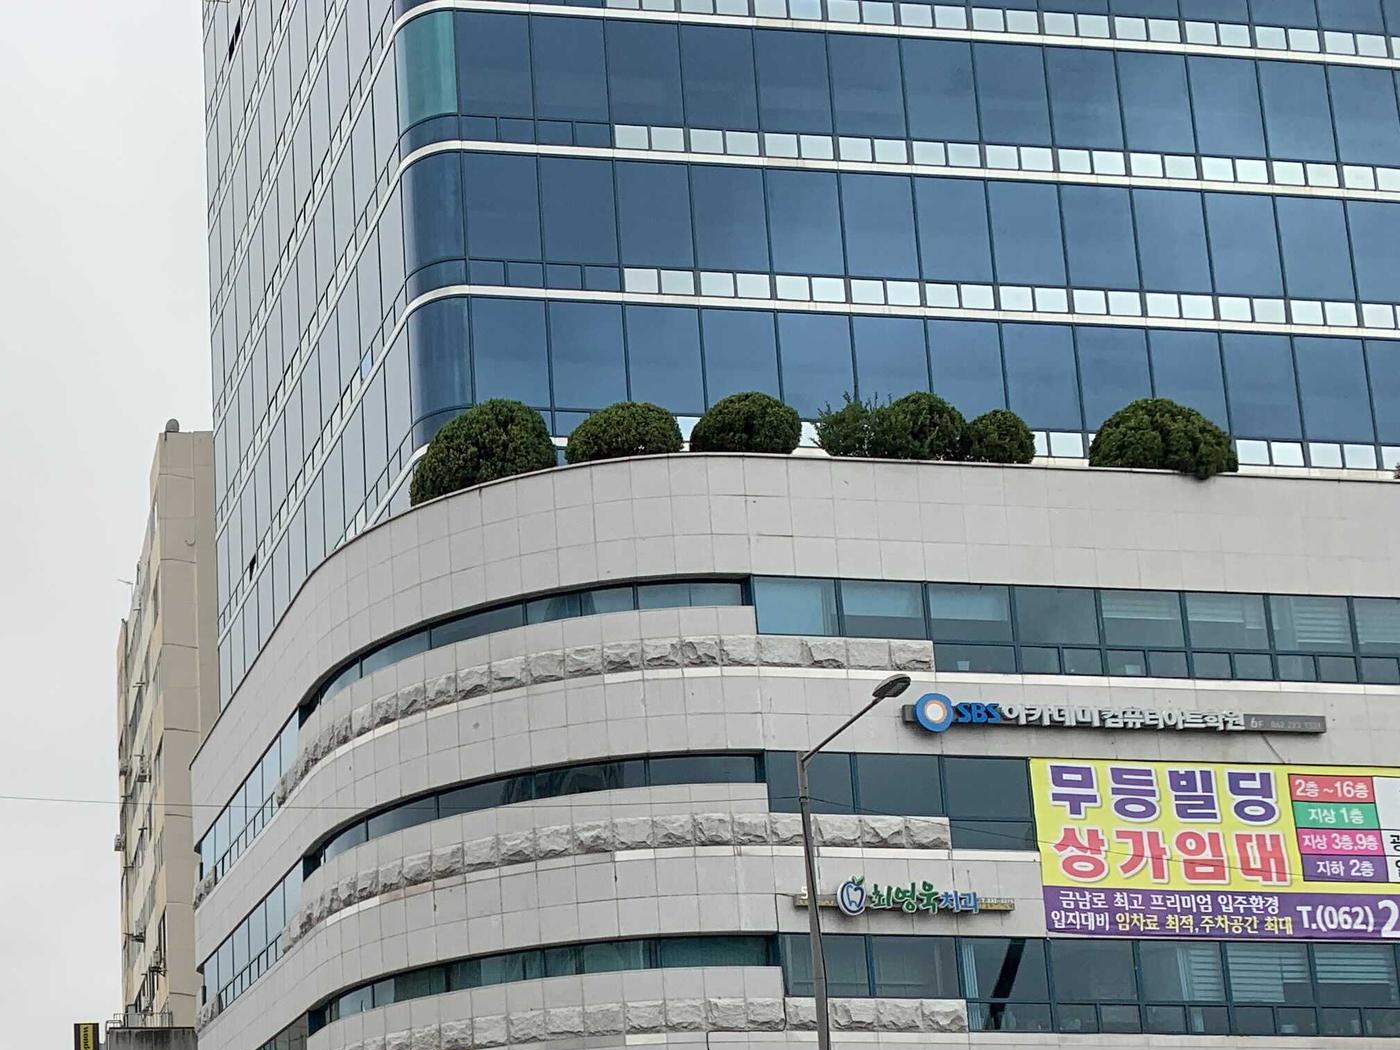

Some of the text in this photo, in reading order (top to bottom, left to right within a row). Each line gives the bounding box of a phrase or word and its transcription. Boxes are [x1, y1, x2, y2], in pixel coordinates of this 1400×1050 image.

[957, 702, 1000, 724] SBS
[1048, 763, 1279, 824] 무등빌딩
[1295, 779, 1320, 797] 2층
[1308, 808, 1364, 824] 지상 1층
[1302, 834, 1327, 850] 지상
[1051, 826, 1290, 884] 상가임대
[1316, 859, 1375, 877] 지하 2층
[1059, 889, 1279, 915] 금남로 최고 프리미엄 입주환경
[1051, 910, 1110, 930] 입지대비
[1115, 912, 1160, 931] 임차료
[1264, 916, 1293, 935] 최대
[1296, 905, 1374, 932] T.(062)
